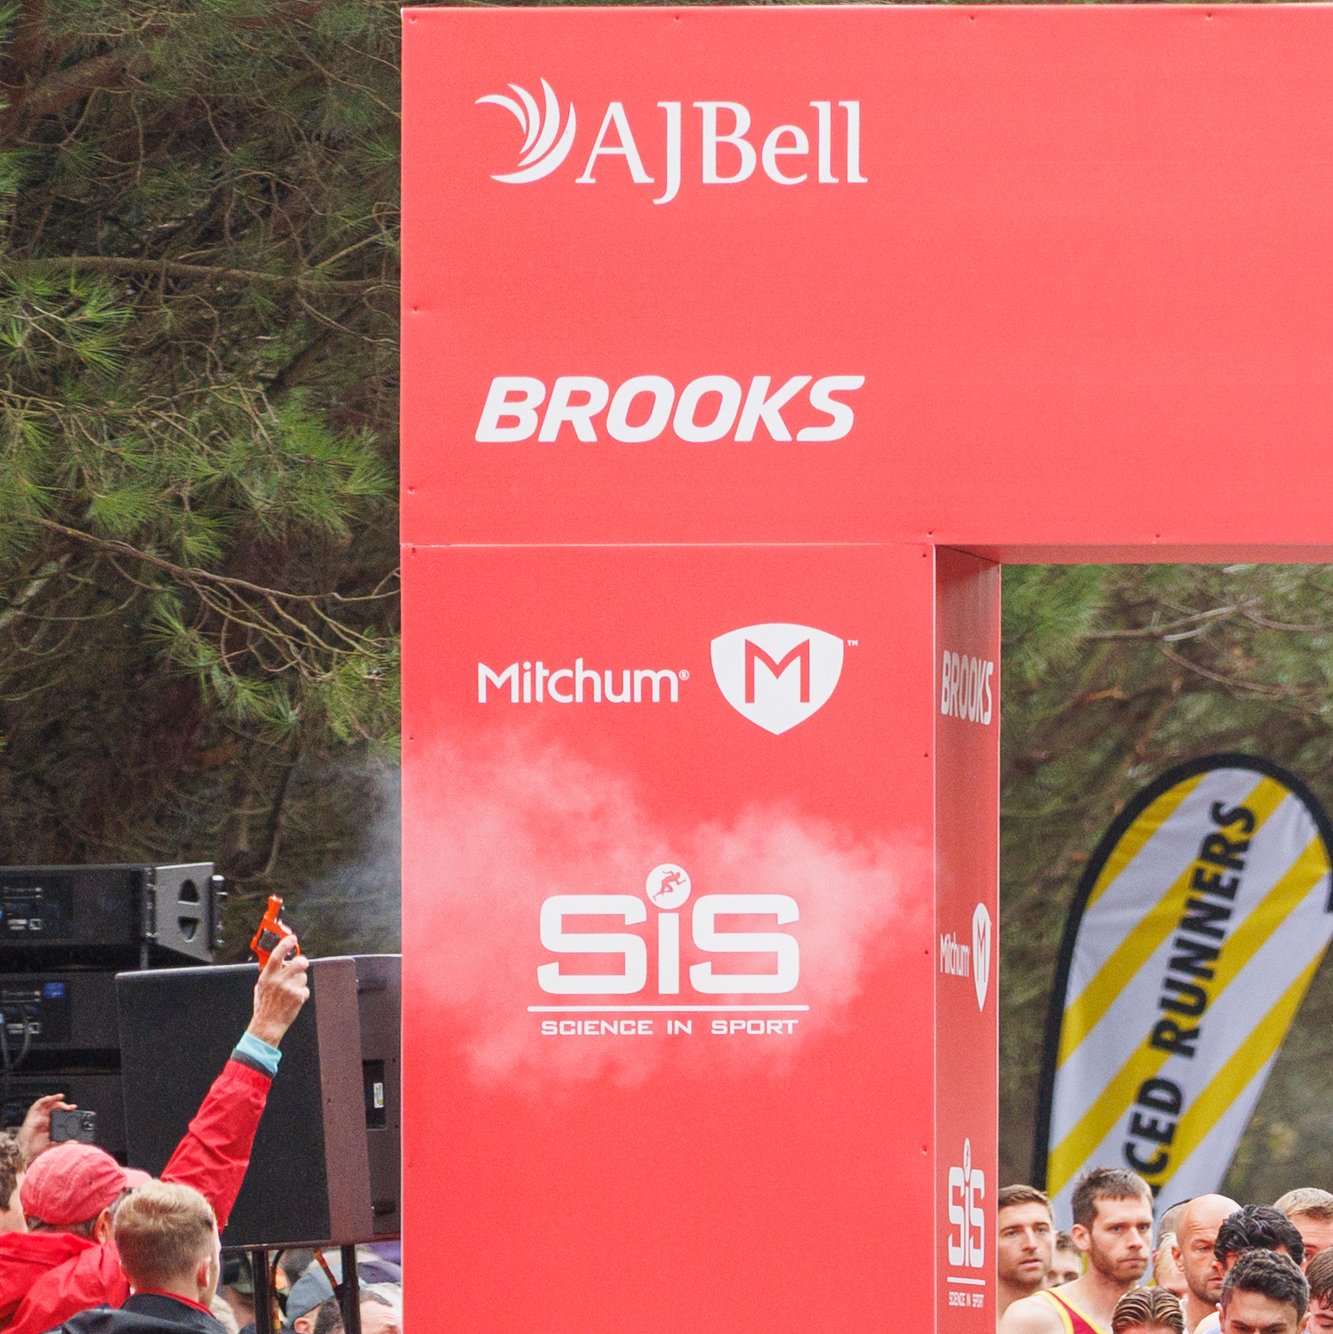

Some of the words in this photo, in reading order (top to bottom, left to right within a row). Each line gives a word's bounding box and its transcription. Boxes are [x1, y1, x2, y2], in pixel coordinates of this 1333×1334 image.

[475, 375, 865, 443] BROOKS
[940, 649, 994, 726] BROOKS
[940, 931, 970, 978] Mitchum
[1149, 801, 1257, 1059] RUNNERS
[541, 1018, 654, 1036] SCIENCE
[667, 1018, 692, 1036] IN
[711, 1018, 799, 1036] SPORT
